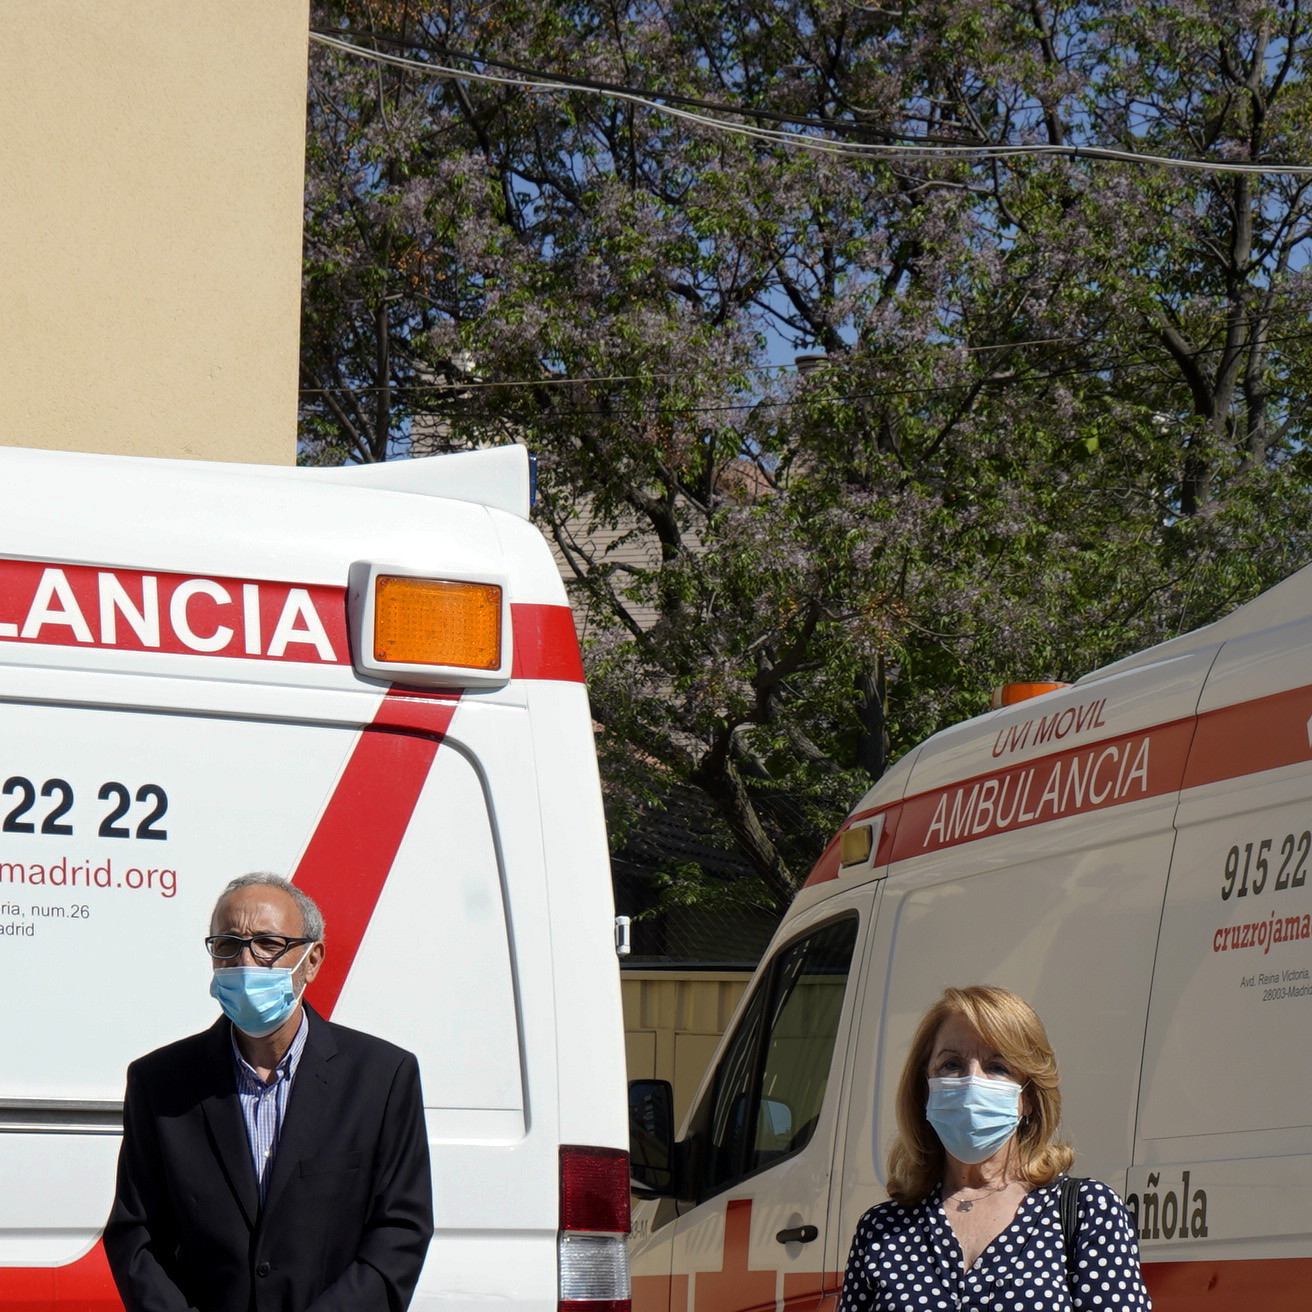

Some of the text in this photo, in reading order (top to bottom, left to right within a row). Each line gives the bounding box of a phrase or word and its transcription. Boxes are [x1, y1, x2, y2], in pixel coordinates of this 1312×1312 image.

[992, 698, 1107, 758] UVI MOVIL
[1, 775, 74, 836] 22
[97, 781, 169, 841] 22
[922, 737, 1150, 847] AMBULANCIA
[1221, 838, 1273, 901] 915
[1274, 831, 1312, 891] 22
[31, 904, 90, 919] num.26
[1258, 973, 1279, 986] Reina
